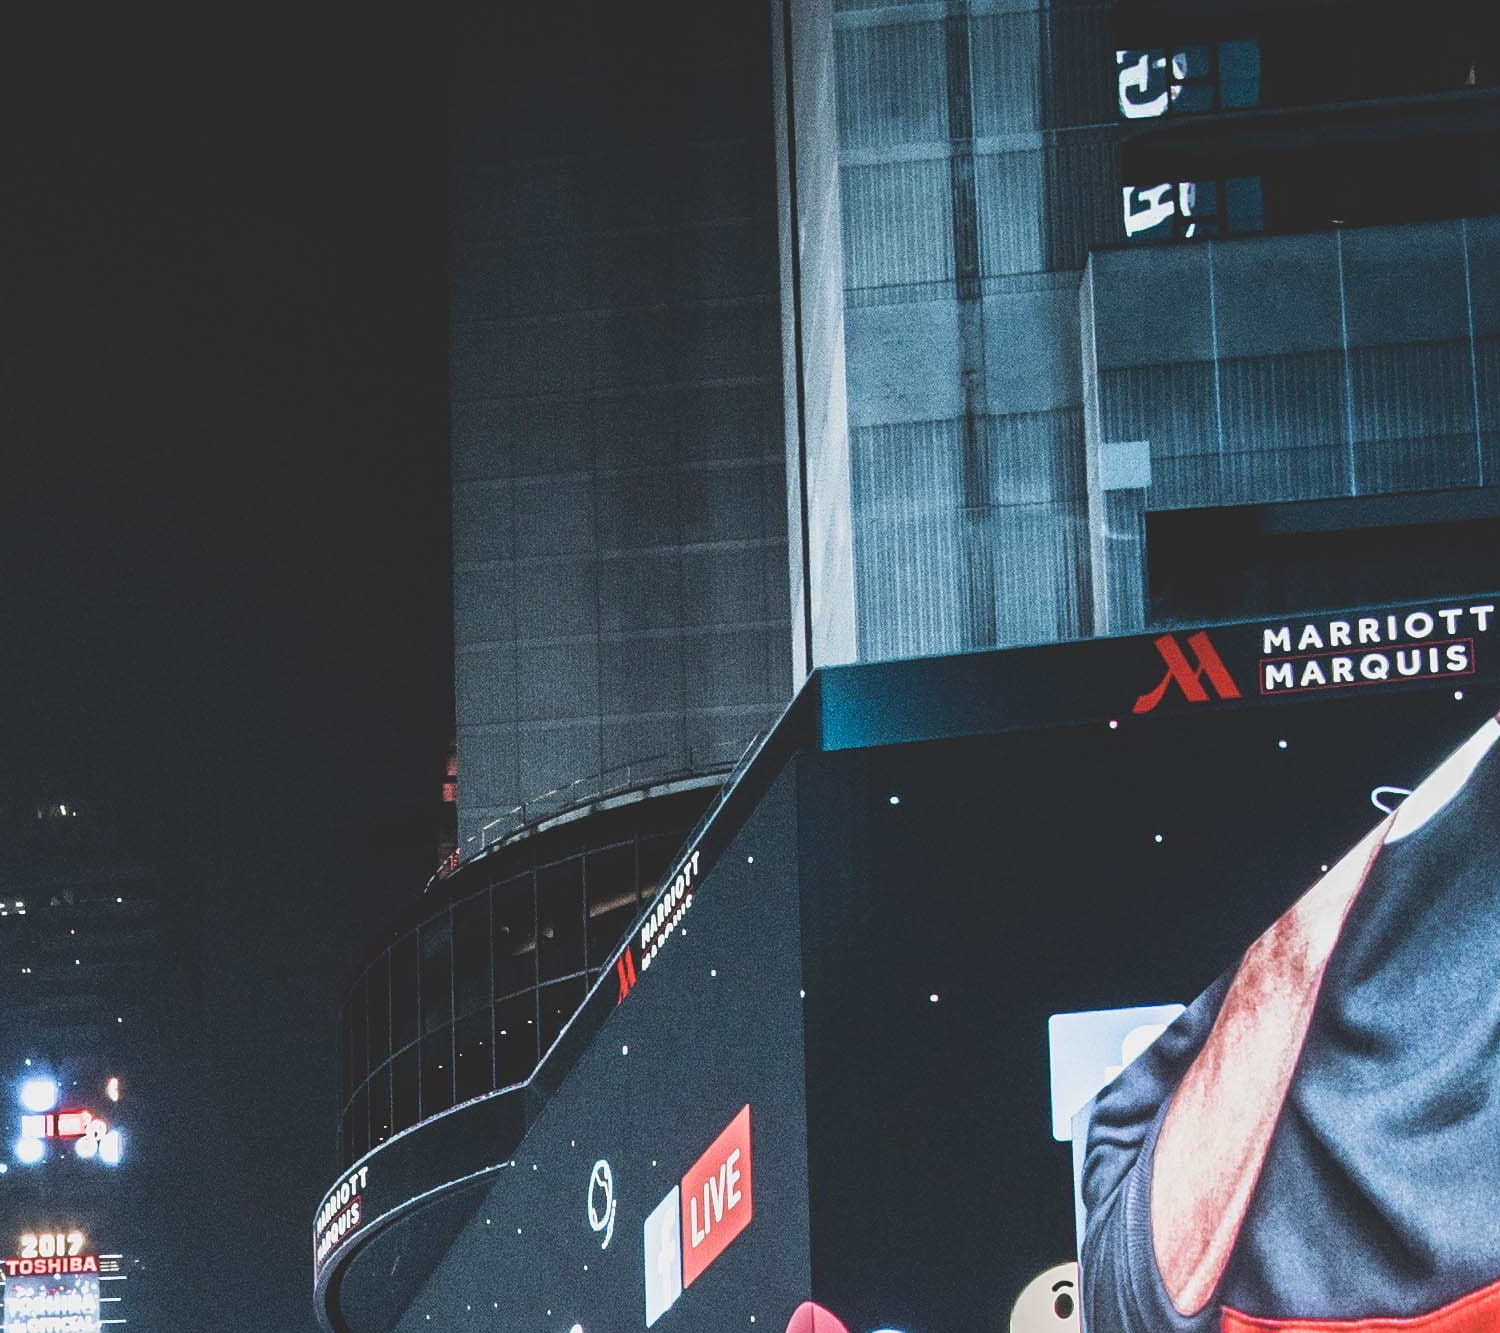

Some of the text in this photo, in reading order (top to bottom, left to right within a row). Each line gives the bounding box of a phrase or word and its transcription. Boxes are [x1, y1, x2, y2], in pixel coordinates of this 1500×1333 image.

[1262, 603, 1496, 653] MARRIOTT
[1263, 644, 1470, 691] MARQUIS
[641, 850, 701, 949] MARRIOTT
[690, 1148, 742, 1249] LIVE
[5, 1255, 98, 1276] TOSHIBA
[20, 1233, 84, 1258] 2017
